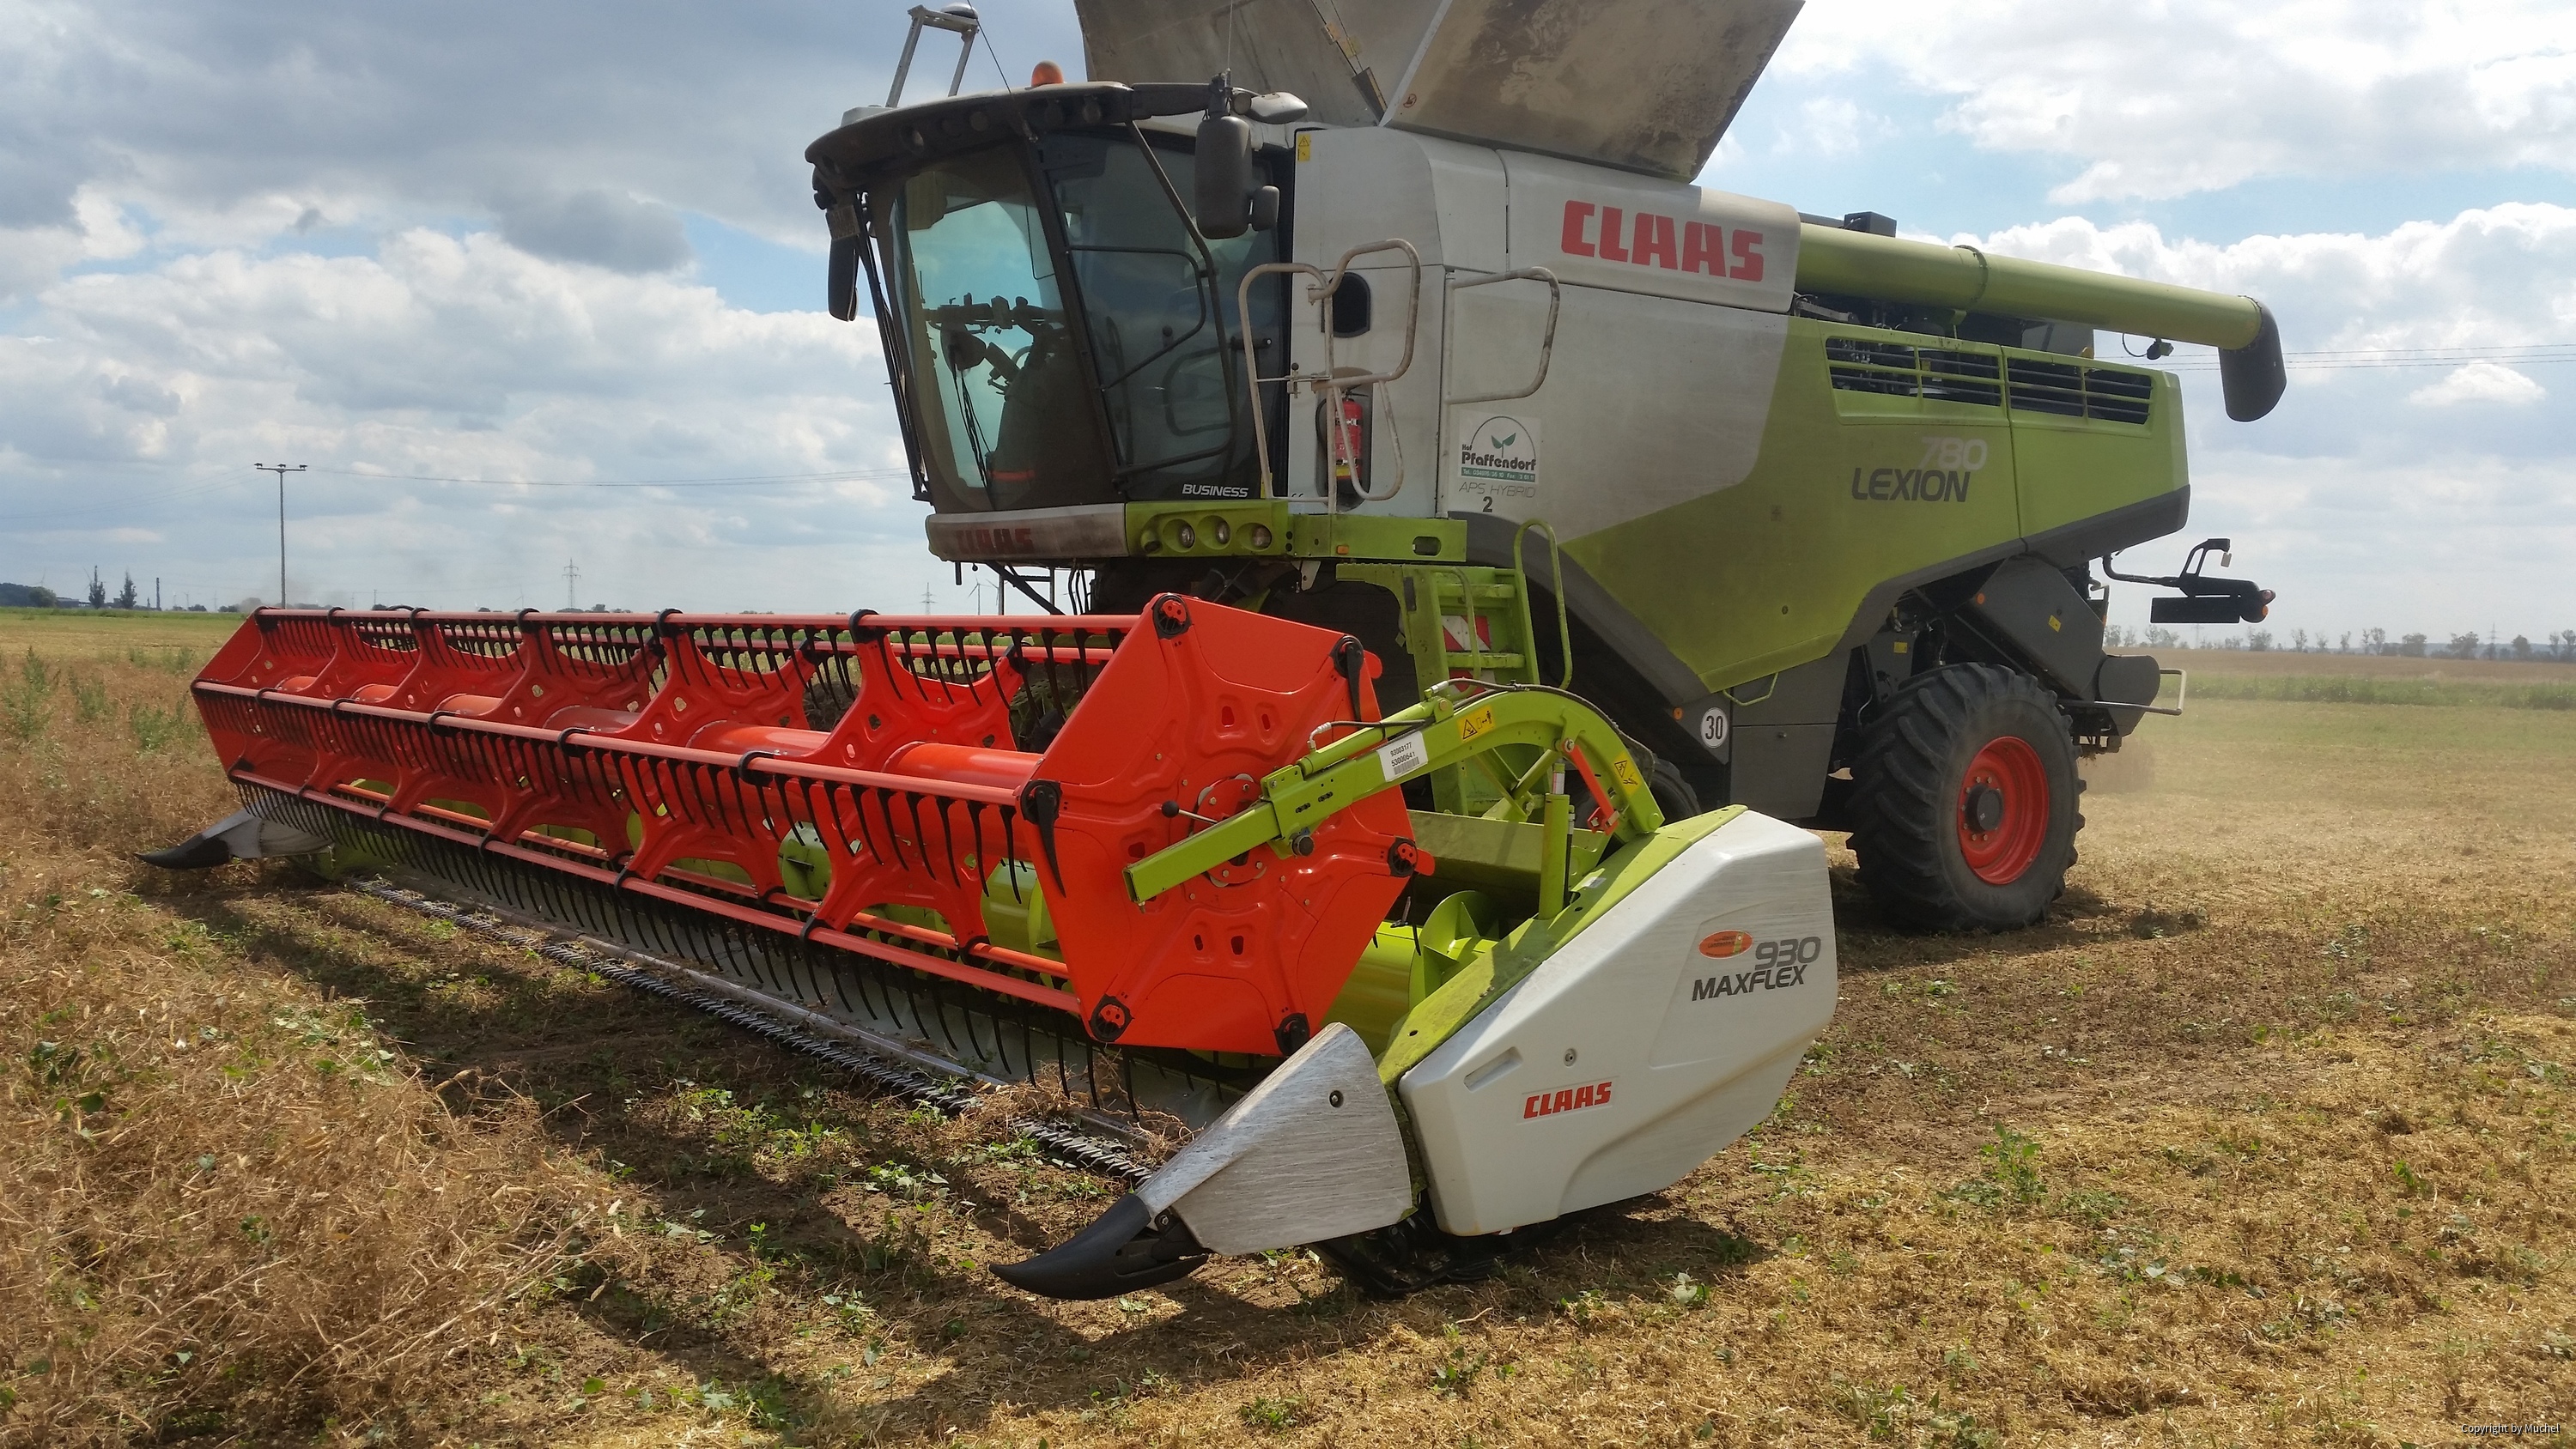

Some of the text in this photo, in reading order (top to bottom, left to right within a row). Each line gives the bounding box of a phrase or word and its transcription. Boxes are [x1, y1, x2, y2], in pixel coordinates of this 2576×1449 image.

[1561, 199, 1764, 282] CLAAS
[1461, 452, 1536, 470] Pfaffendorf
[1917, 435, 1988, 470] 780
[1182, 483, 1249, 498] BUSINESS
[1459, 482, 1536, 498] APS HYBRID
[1851, 467, 1971, 502] LEXION
[1482, 496, 1493, 512] 2
[955, 528, 1035, 555] CLAAS
[1705, 715, 1723, 739] 30
[1754, 936, 1821, 970] 930
[1692, 964, 1807, 1002] MAXFLEX
[1523, 1082, 1613, 1119] CLAAS
